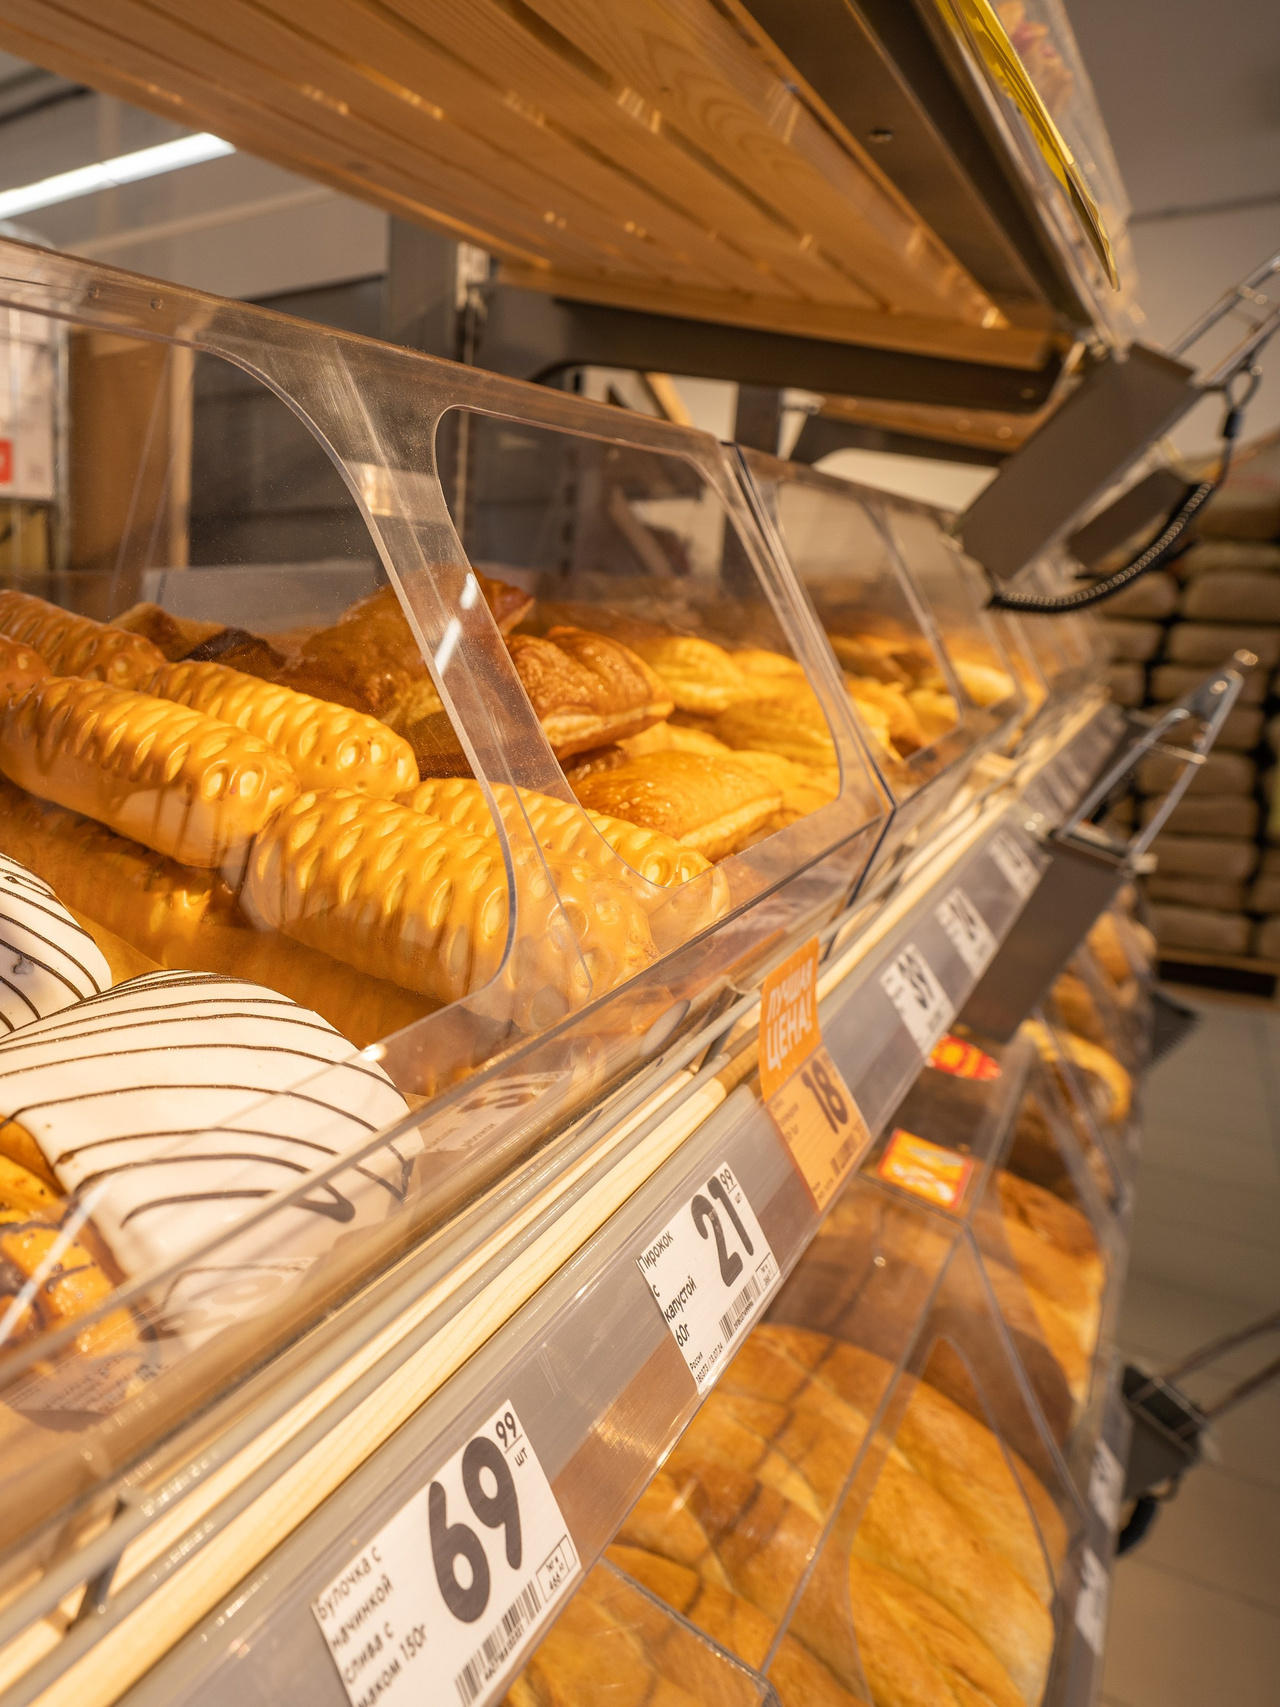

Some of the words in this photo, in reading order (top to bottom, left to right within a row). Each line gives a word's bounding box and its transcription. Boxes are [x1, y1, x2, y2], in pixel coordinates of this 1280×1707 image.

[766, 988, 813, 1071] ЦЕНА!
[801, 1059, 849, 1135] 18
[719, 1168, 734, 1191] 99
[637, 1231, 674, 1274] Пирожок
[691, 1175, 754, 1287] 21
[652, 1284, 660, 1297] с
[664, 1274, 697, 1323] капустой
[675, 1323, 690, 1348] 60г
[515, 1447, 528, 1466] шт
[429, 1436, 522, 1624] 69
[496, 1411, 517, 1448] 99
[372, 1547, 381, 1562] с
[332, 1573, 394, 1650] начинкой
[345, 1634, 384, 1684] слива
[384, 1622, 394, 1639] с
[399, 1623, 427, 1661] 150г
